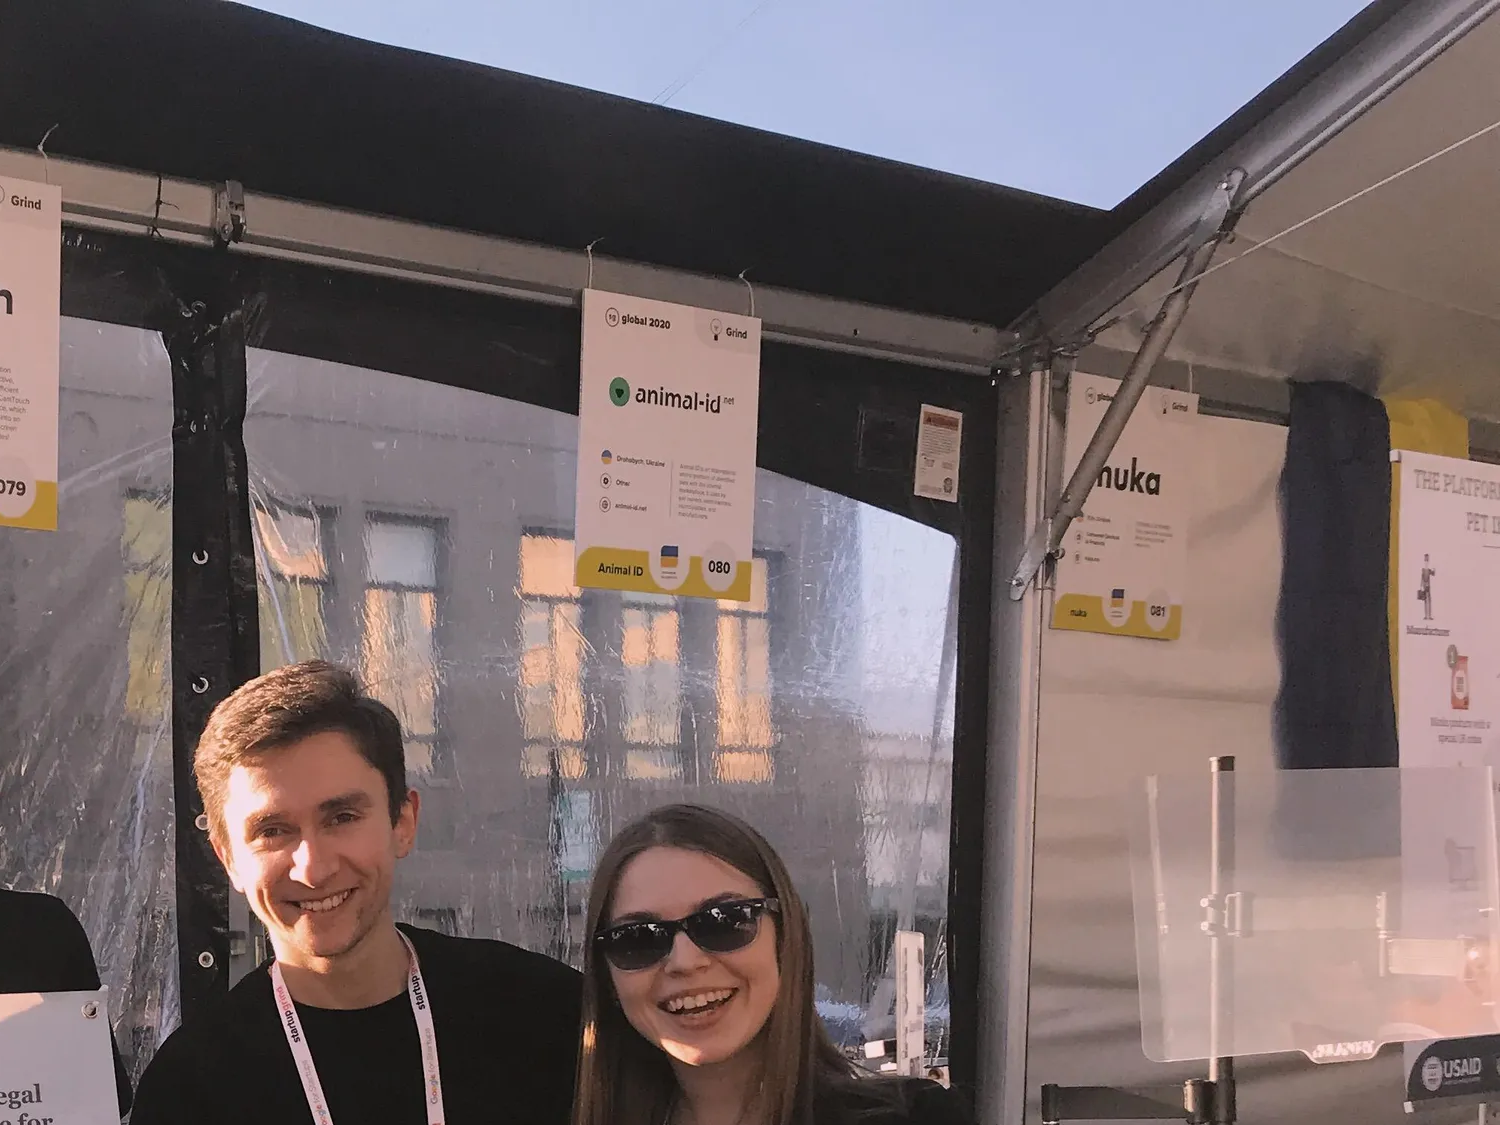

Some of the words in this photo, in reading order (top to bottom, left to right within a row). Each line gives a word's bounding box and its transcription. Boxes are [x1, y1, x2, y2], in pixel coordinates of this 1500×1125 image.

[11, 195, 42, 210] Grind
[622, 314, 647, 326] global
[649, 318, 671, 329] 2020
[726, 327, 747, 339] Grind
[635, 386, 721, 414] animal-id
[1414, 469, 1440, 491] THE
[1466, 512, 1489, 534] PET
[598, 562, 631, 577] Animal
[633, 566, 644, 577] ID
[708, 560, 730, 574] 080
[1150, 605, 1166, 617] 081
[276, 986, 300, 1043] startupgrind
[1443, 1057, 1482, 1078] USAID
